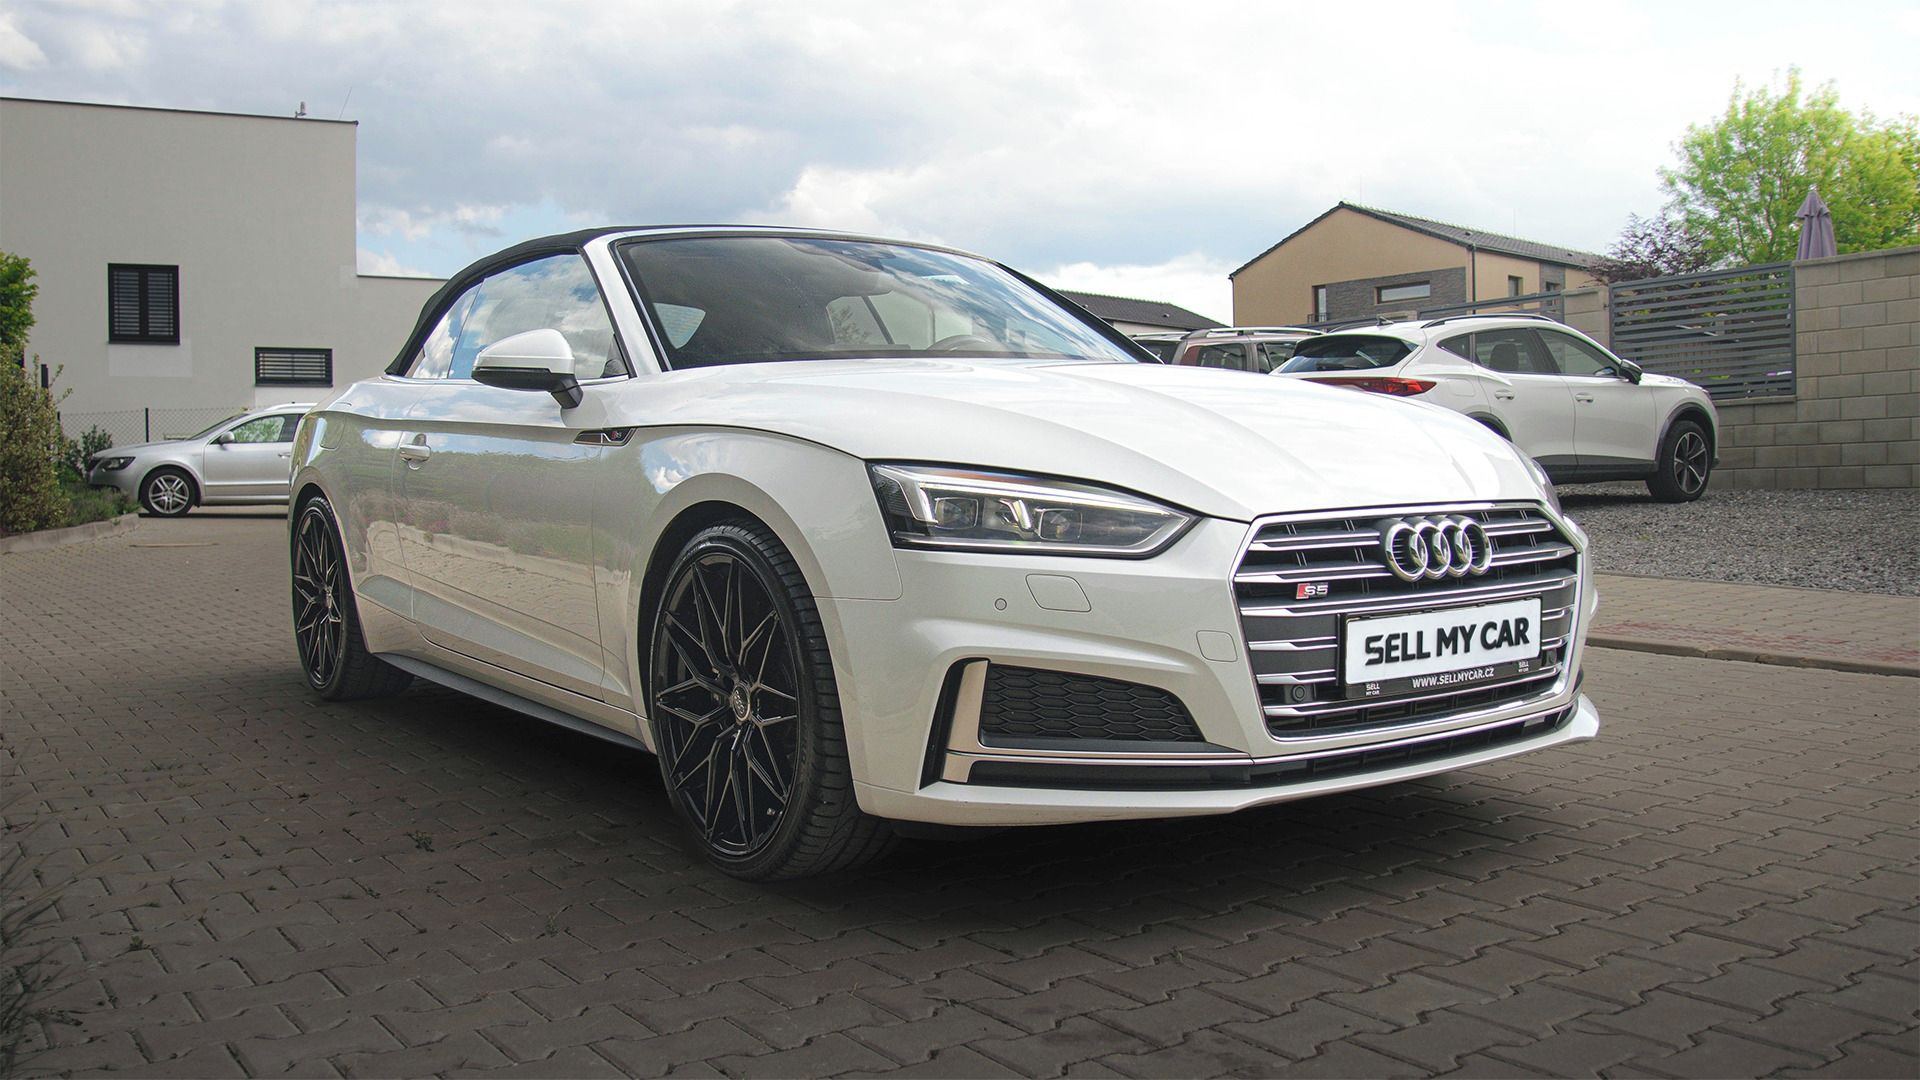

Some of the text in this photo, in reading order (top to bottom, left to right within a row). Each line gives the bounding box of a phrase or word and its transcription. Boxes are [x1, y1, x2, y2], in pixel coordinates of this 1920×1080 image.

[1365, 617, 1530, 666] SELL MY CAR
[1366, 682, 1380, 691] SELL
[1411, 667, 1495, 689] WWW.SELLMYCAR.CZ
